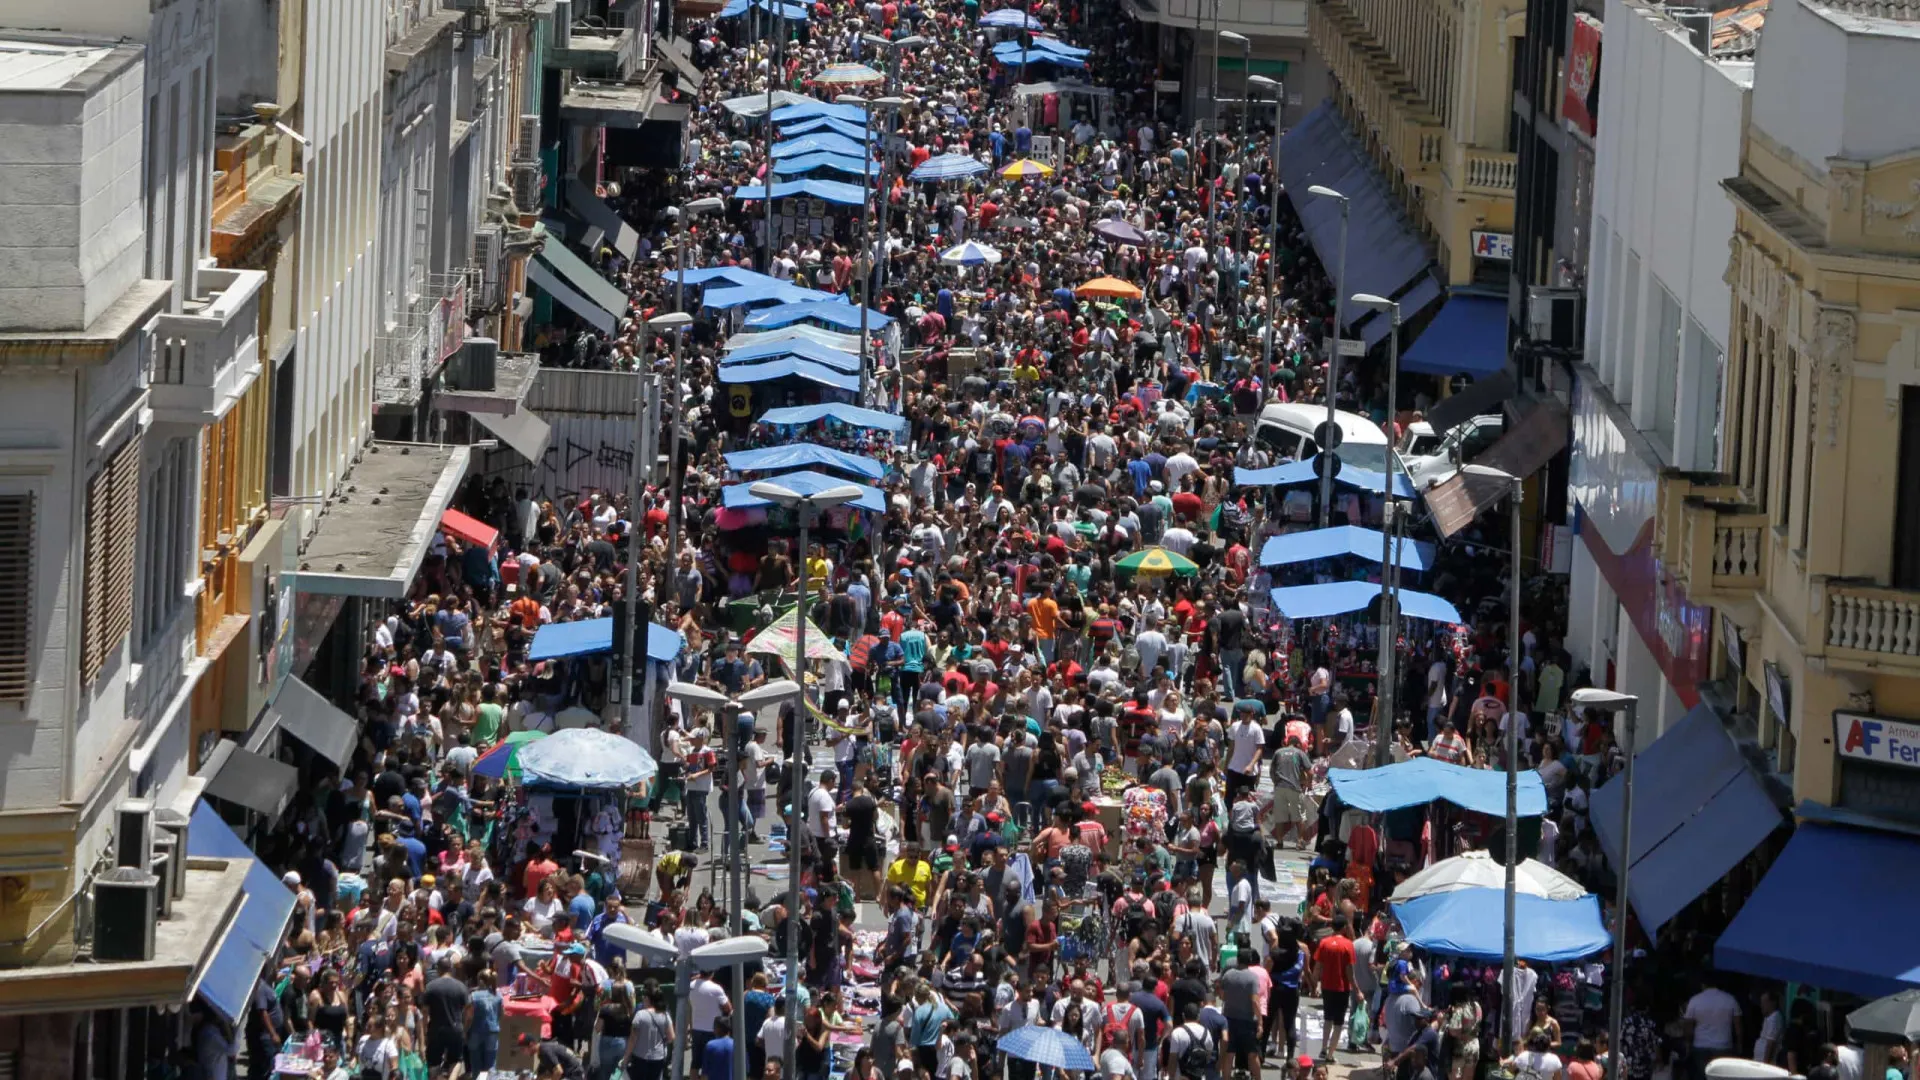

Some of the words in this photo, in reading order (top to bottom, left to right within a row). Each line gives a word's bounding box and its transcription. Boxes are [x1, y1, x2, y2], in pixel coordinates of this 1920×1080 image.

[1477, 233, 1498, 255] AF
[1845, 719, 1883, 756] AF
[1889, 738, 1920, 763] Fer
